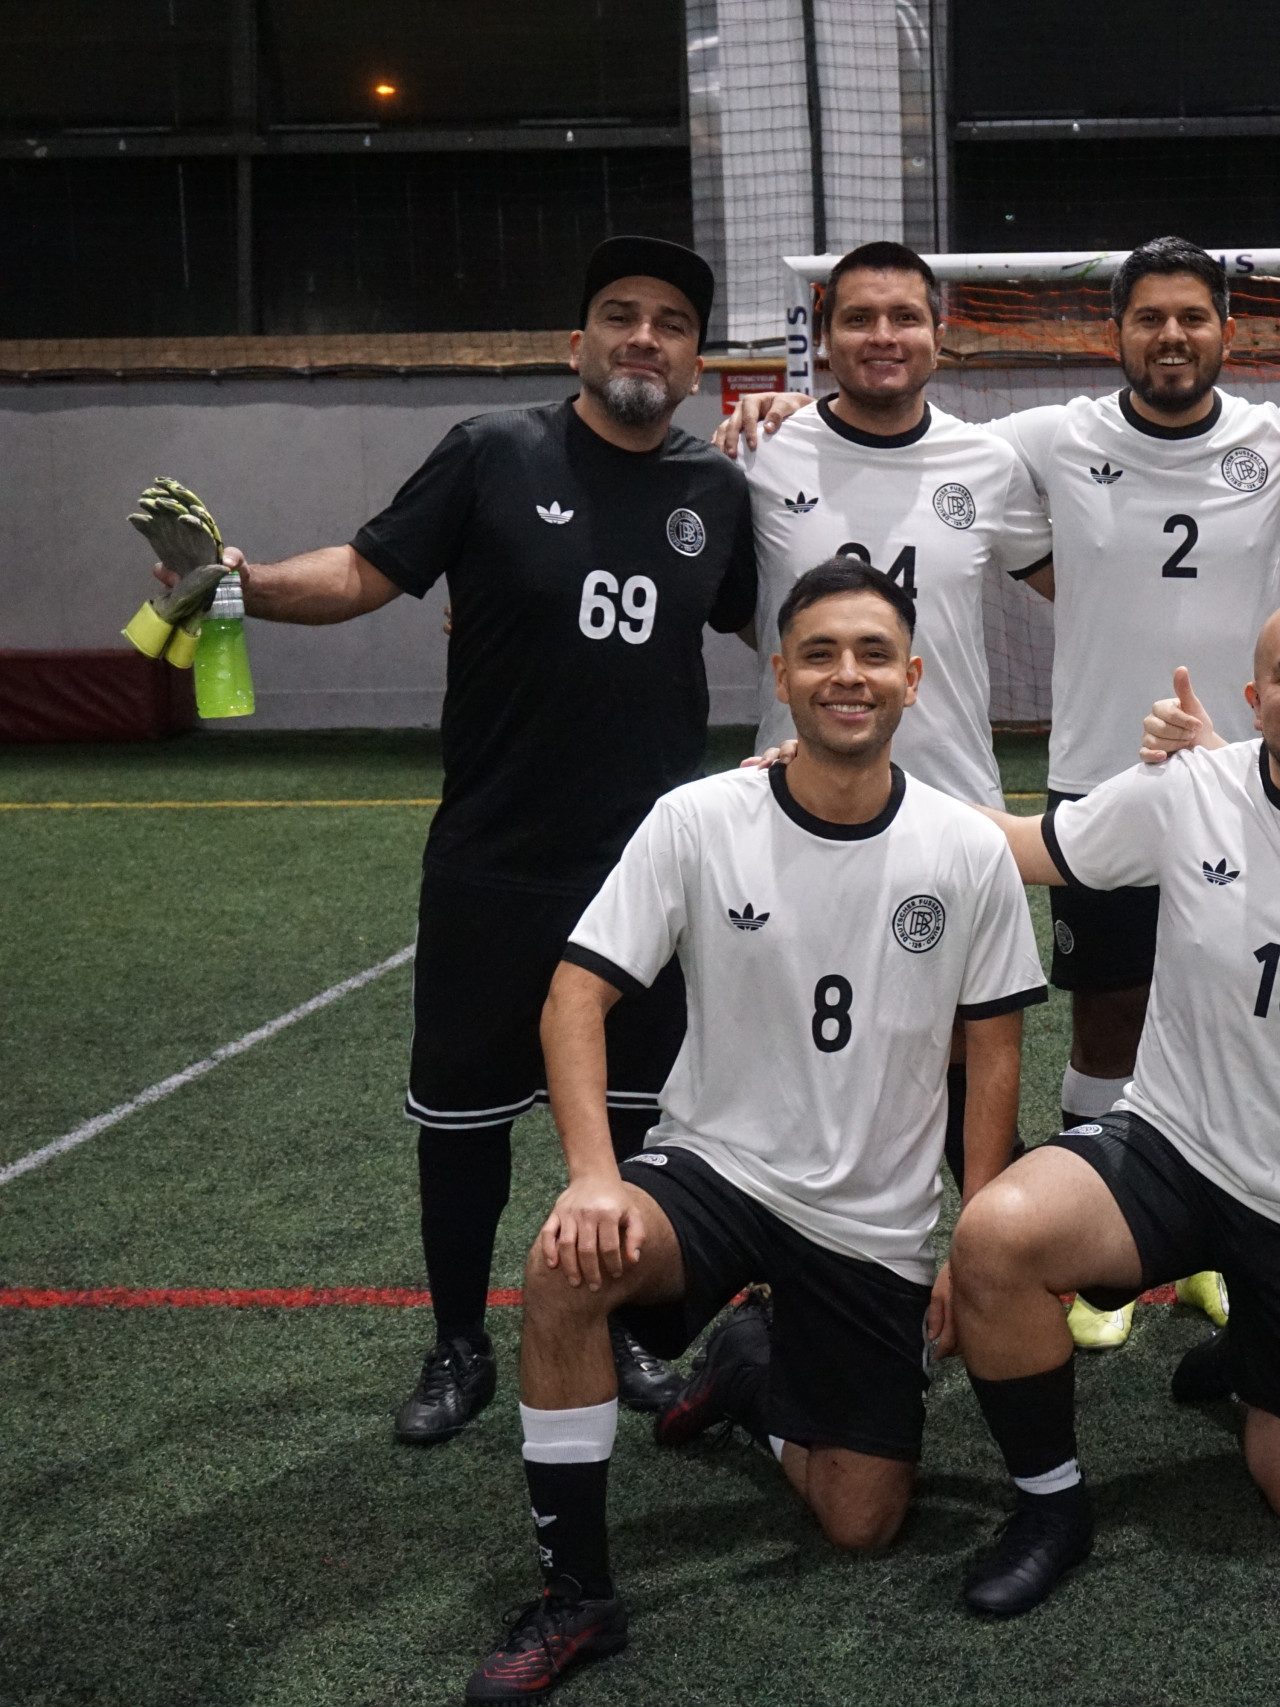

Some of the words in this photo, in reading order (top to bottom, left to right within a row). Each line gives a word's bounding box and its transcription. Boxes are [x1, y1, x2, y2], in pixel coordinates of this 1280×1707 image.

[787, 306, 809, 395] LUS
[835, 542, 918, 599] 4
[1162, 514, 1198, 578] 2
[579, 570, 657, 644] 69
[812, 974, 852, 1053] 8
